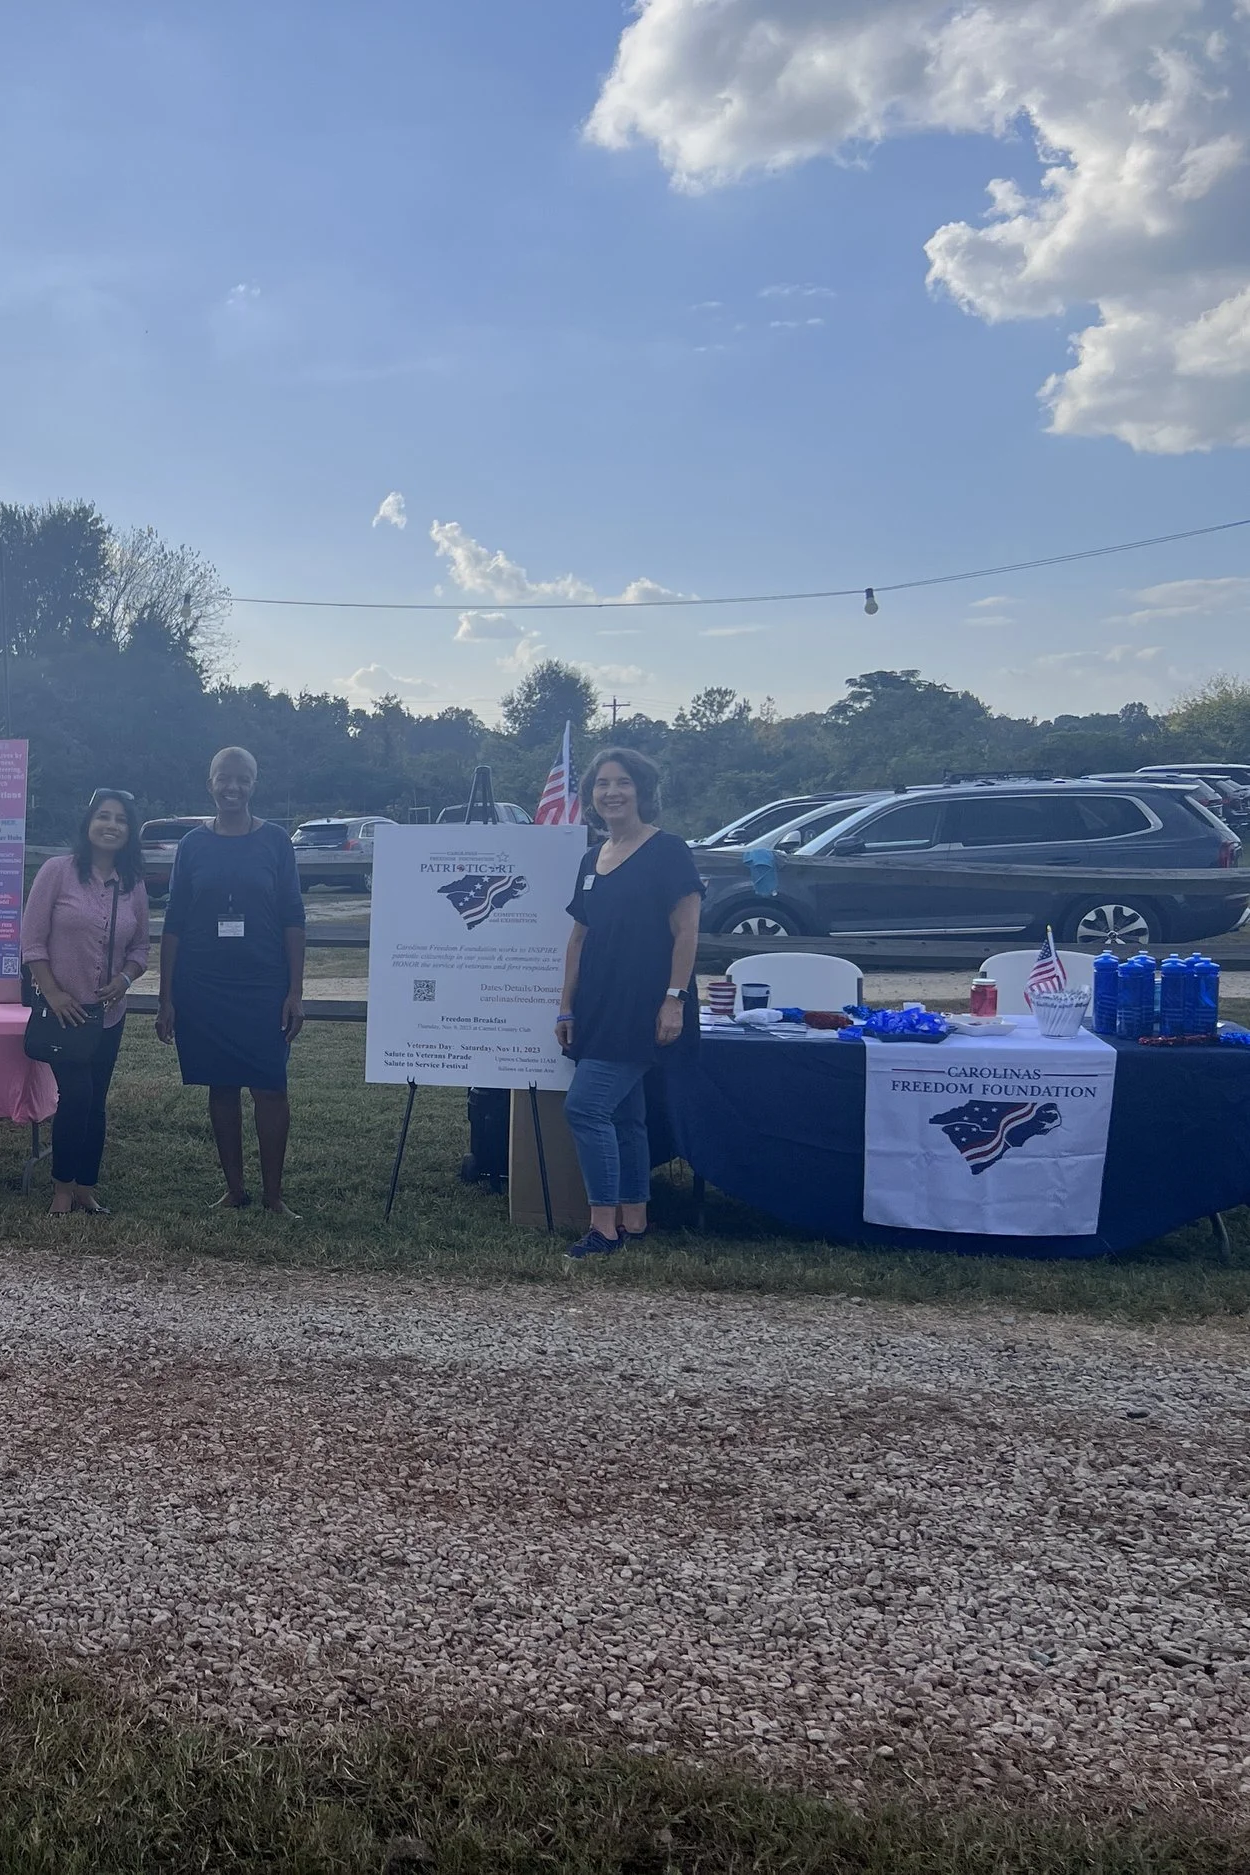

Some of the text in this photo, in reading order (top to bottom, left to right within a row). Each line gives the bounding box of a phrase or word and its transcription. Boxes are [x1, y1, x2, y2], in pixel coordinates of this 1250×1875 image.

[480, 995, 561, 1005] carolinasfreedom.org
[474, 1016, 506, 1024] Breakfast
[439, 1043, 455, 1051] Day:
[461, 1044, 494, 1052] Saturday,
[416, 1052, 446, 1060] Veterans
[442, 1061, 468, 1070] Festival
[947, 1067, 1041, 1080] CAROLINAS
[891, 1080, 1097, 1098] FREEDOM FOUNDATION
